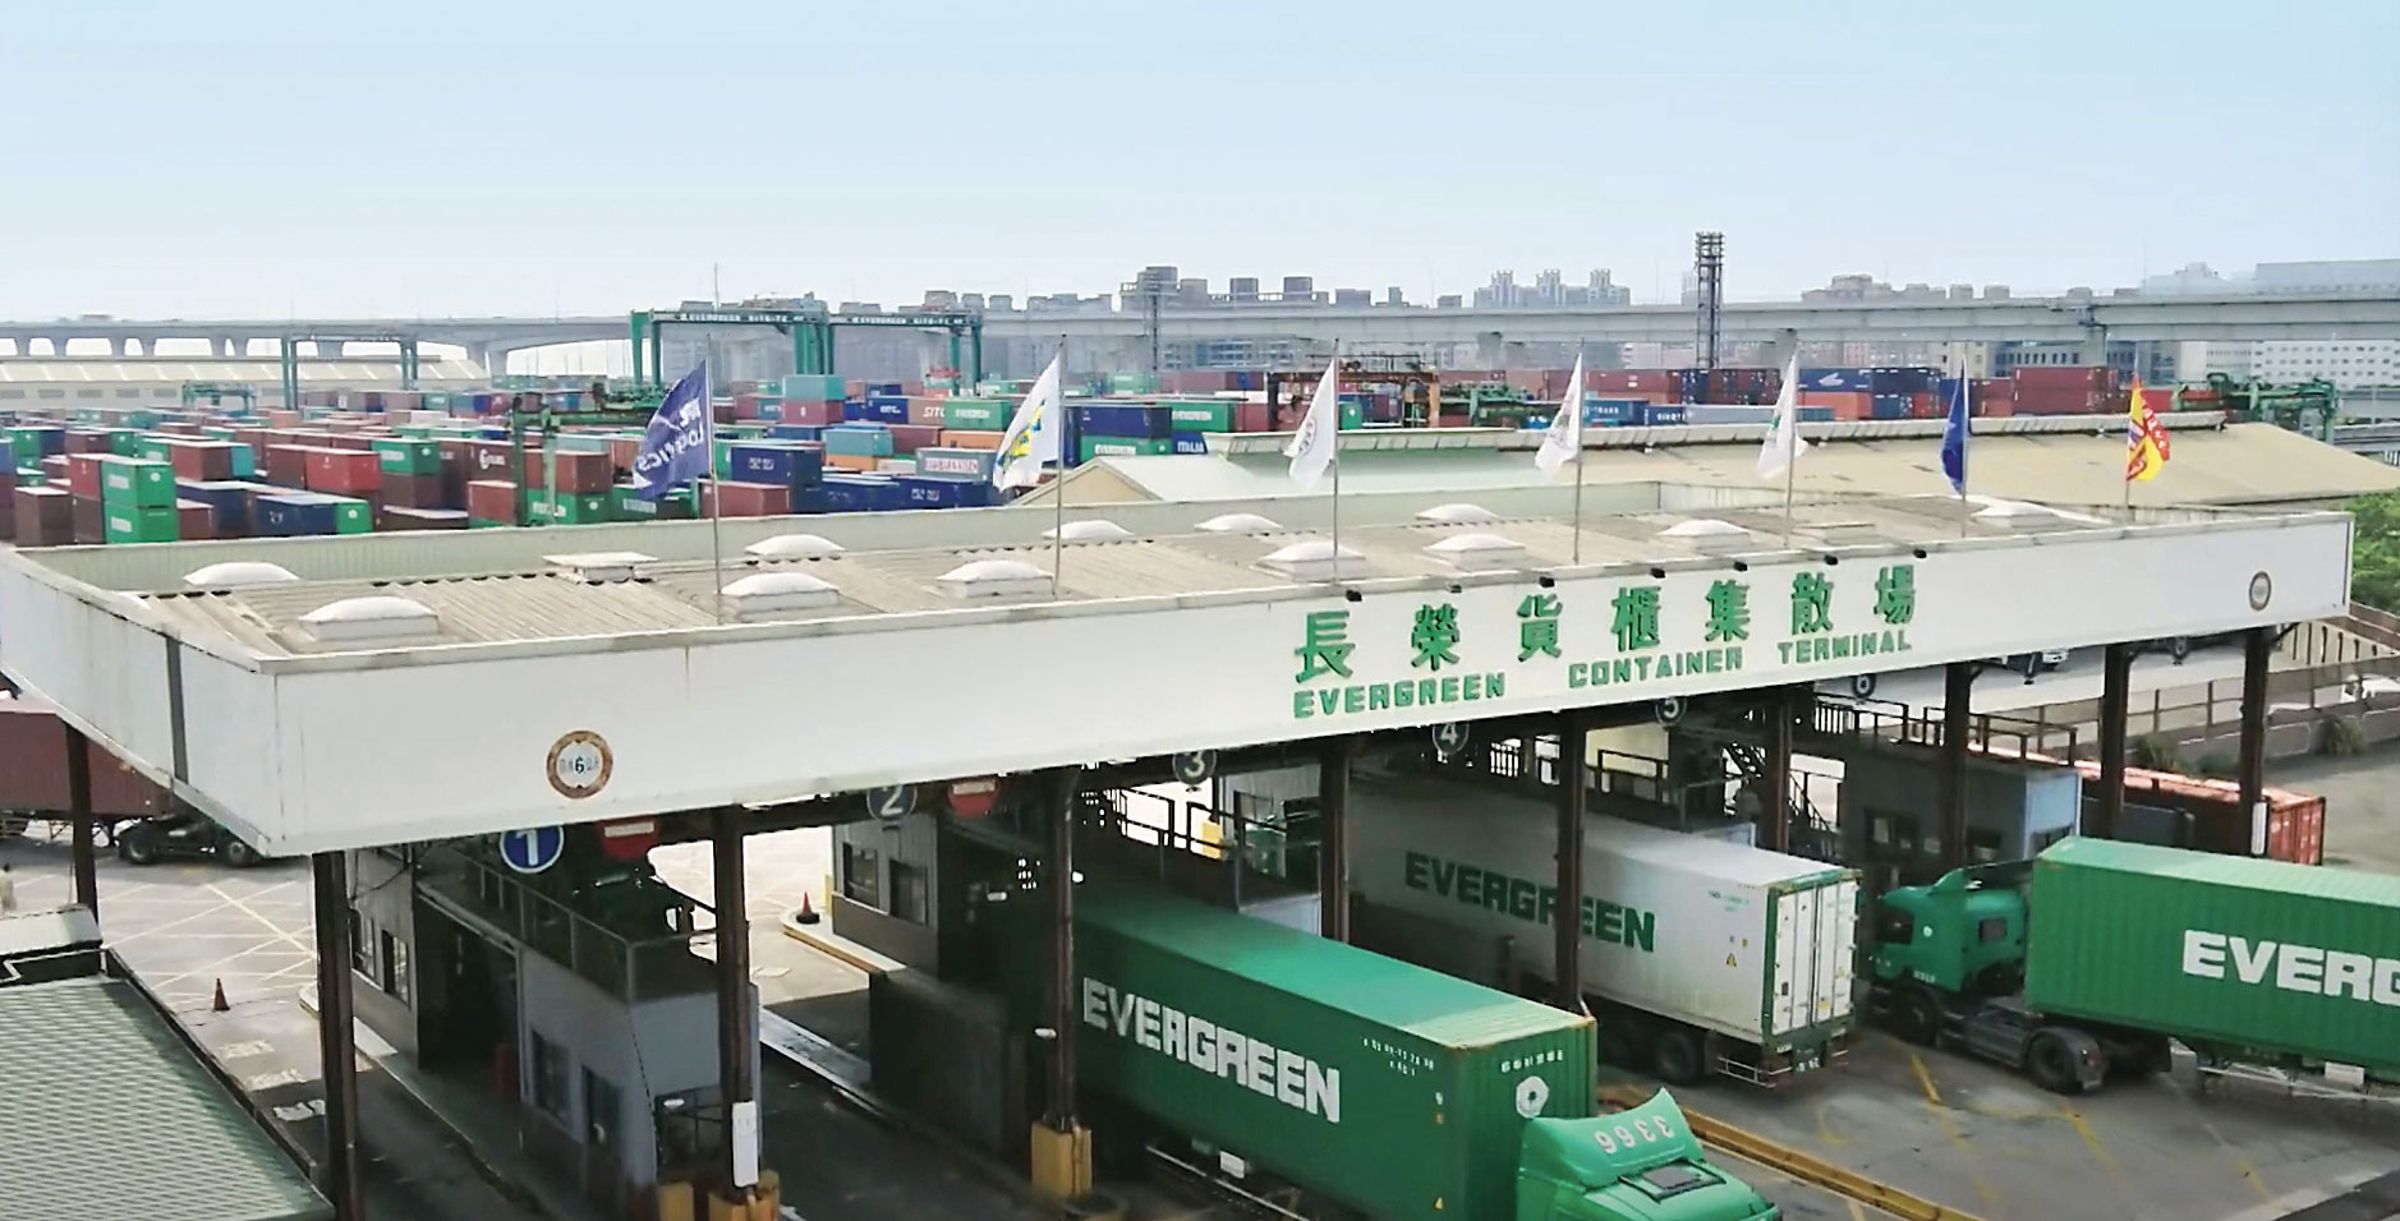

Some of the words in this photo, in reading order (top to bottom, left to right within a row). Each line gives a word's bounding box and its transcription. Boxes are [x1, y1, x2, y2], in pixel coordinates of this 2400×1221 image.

[1294, 563, 1916, 684] 長榮貨櫃集散場
[1293, 672, 1506, 719] EVERGREEN
[1568, 646, 1744, 689] CONTAINER
[1776, 629, 1913, 665] TERMINAL
[1440, 721, 1459, 746] 4
[1183, 751, 1206, 778] 3
[880, 783, 904, 816] 2
[514, 829, 539, 866] 1
[1083, 976, 1341, 1125] EVERGREEN
